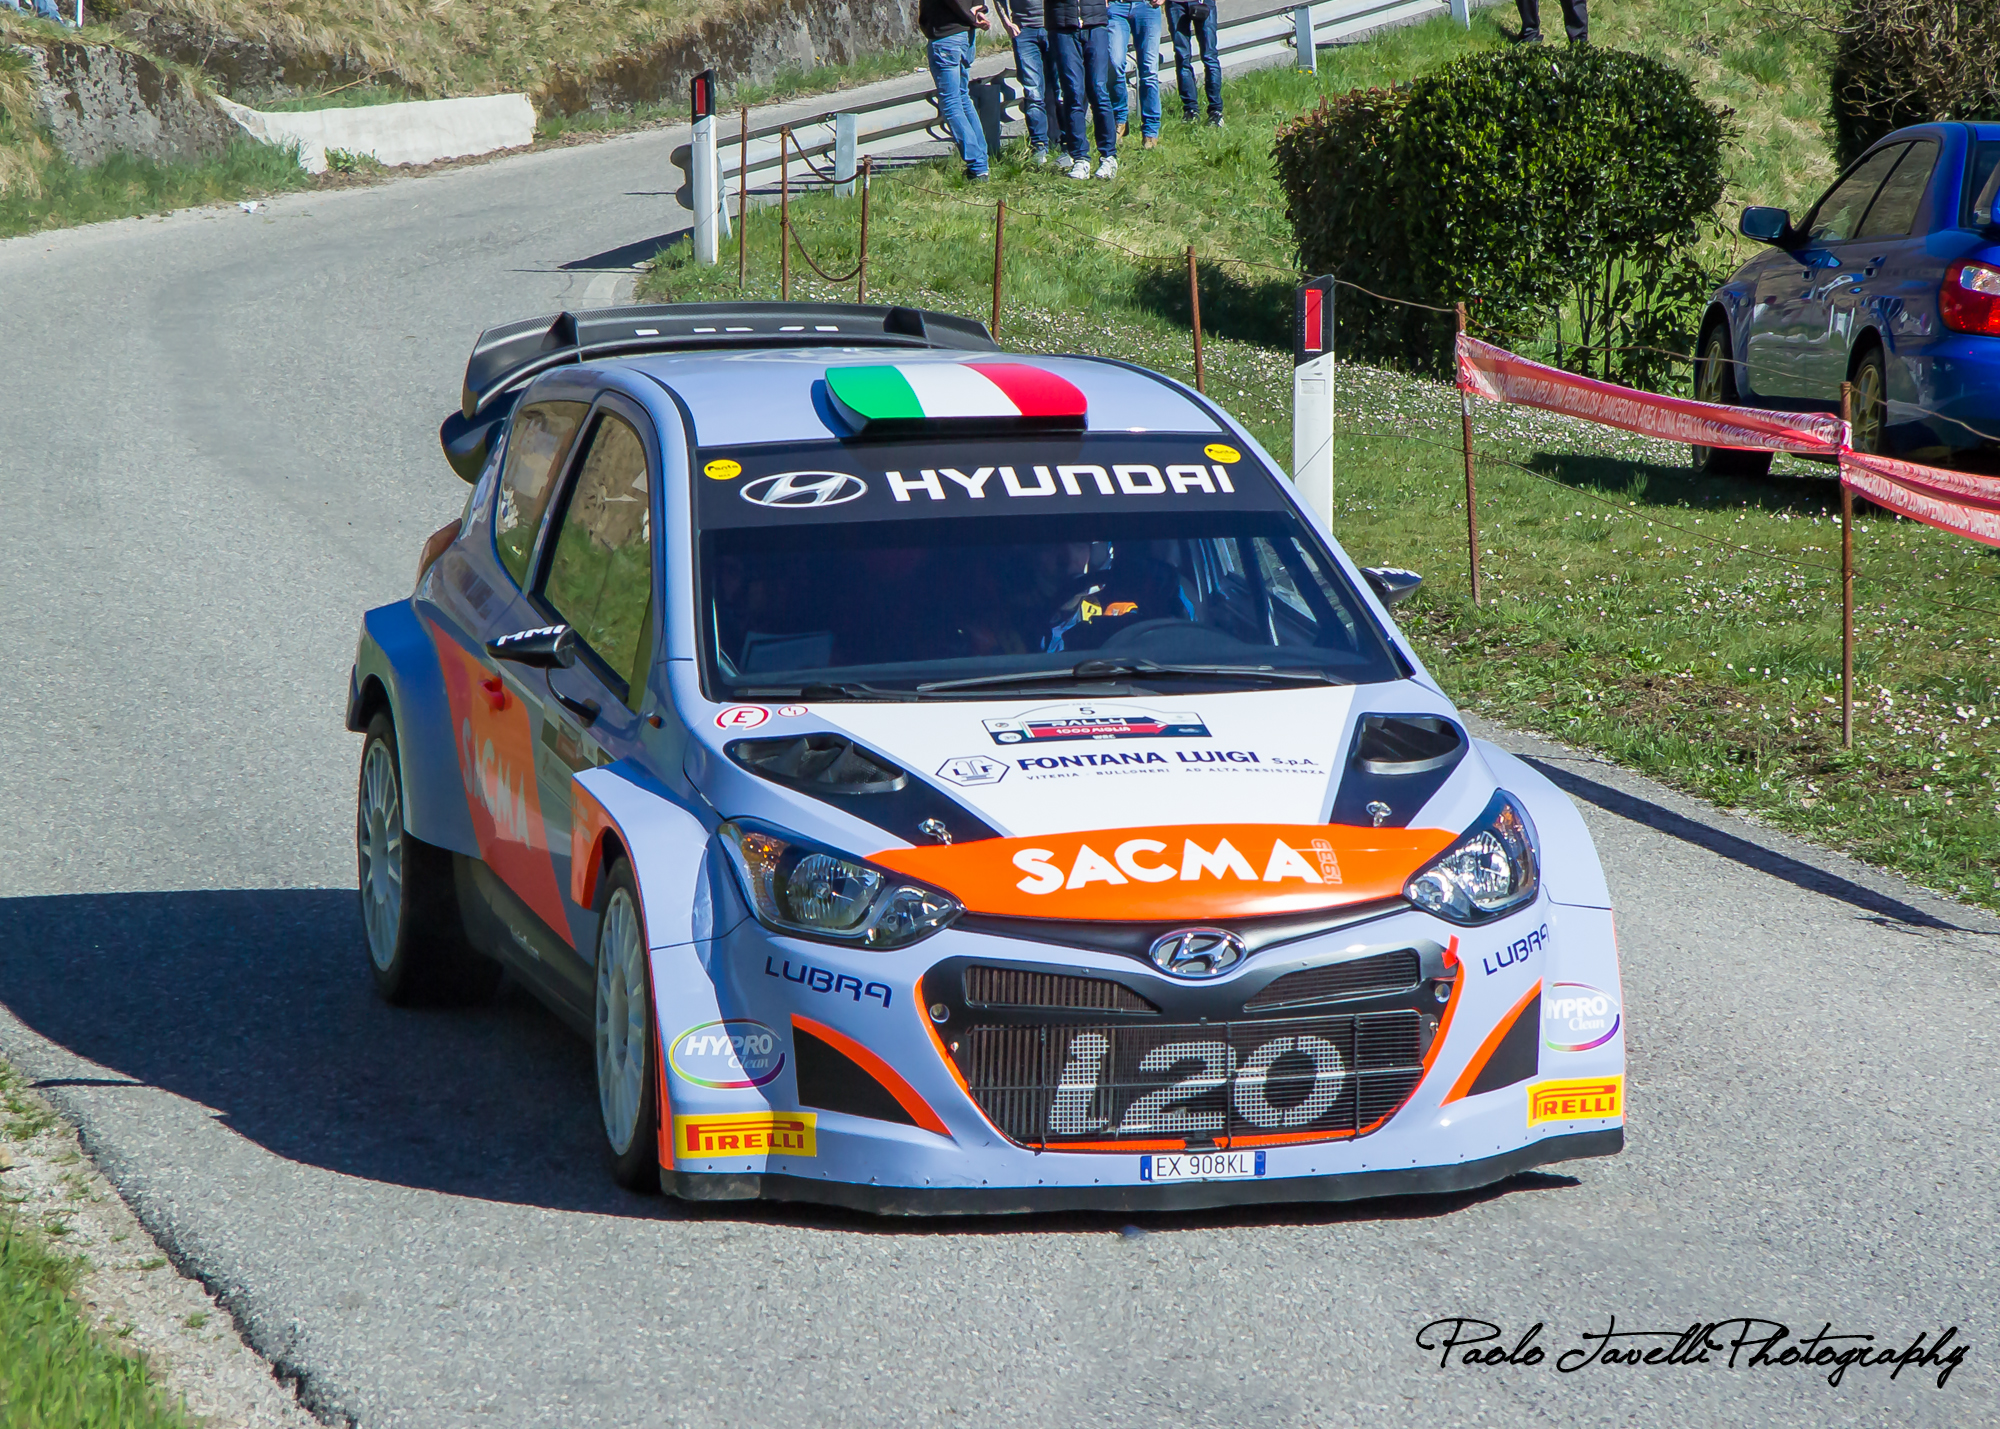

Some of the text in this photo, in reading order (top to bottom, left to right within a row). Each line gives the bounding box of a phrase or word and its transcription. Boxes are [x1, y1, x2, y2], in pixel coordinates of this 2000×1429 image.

[885, 464, 1235, 502] HYUNDAI
[732, 710, 754, 723] E
[1079, 707, 1096, 715] 5
[1017, 751, 1320, 771] FONTANA LUIGI S.p.A.
[1012, 838, 1324, 895] SACMA
[1483, 923, 1550, 976] LUBRA
[764, 955, 893, 1009] LUBRA
[1568, 1016, 1605, 1032] Clean
[684, 1034, 773, 1056] HYPRO
[727, 1056, 770, 1069] Clean
[1532, 1084, 1617, 1120] PIRELLI
[686, 1120, 804, 1152] PIRELLI
[1156, 1154, 1249, 1177] EX 908KL
